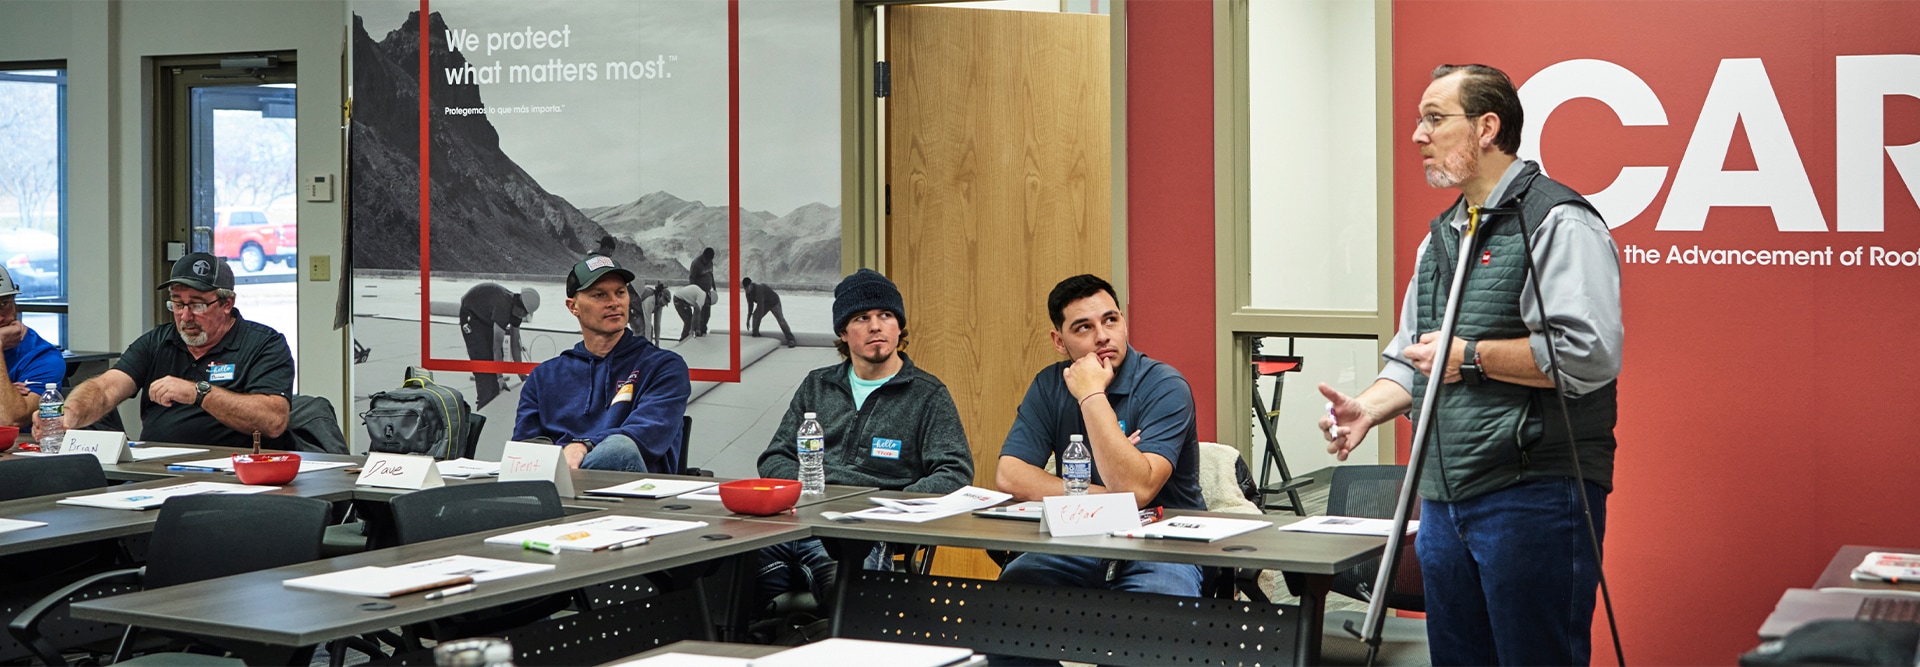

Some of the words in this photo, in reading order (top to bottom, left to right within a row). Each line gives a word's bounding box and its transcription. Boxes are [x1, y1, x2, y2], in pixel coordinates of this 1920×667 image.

[445, 29, 480, 52] We
[487, 24, 571, 56] protect
[445, 60, 502, 85] what
[509, 58, 598, 83] matters
[444, 106, 487, 117] Protegemos
[488, 105, 496, 114] lo
[497, 106, 512, 116] que
[1623, 244, 1660, 264] the
[1665, 244, 1833, 266] Advancement
[1839, 246, 1863, 265] of
[872, 439, 897, 448] hello
[364, 459, 404, 479] Dave
[507, 455, 541, 474] Trent
[1060, 503, 1104, 524] Edgar
